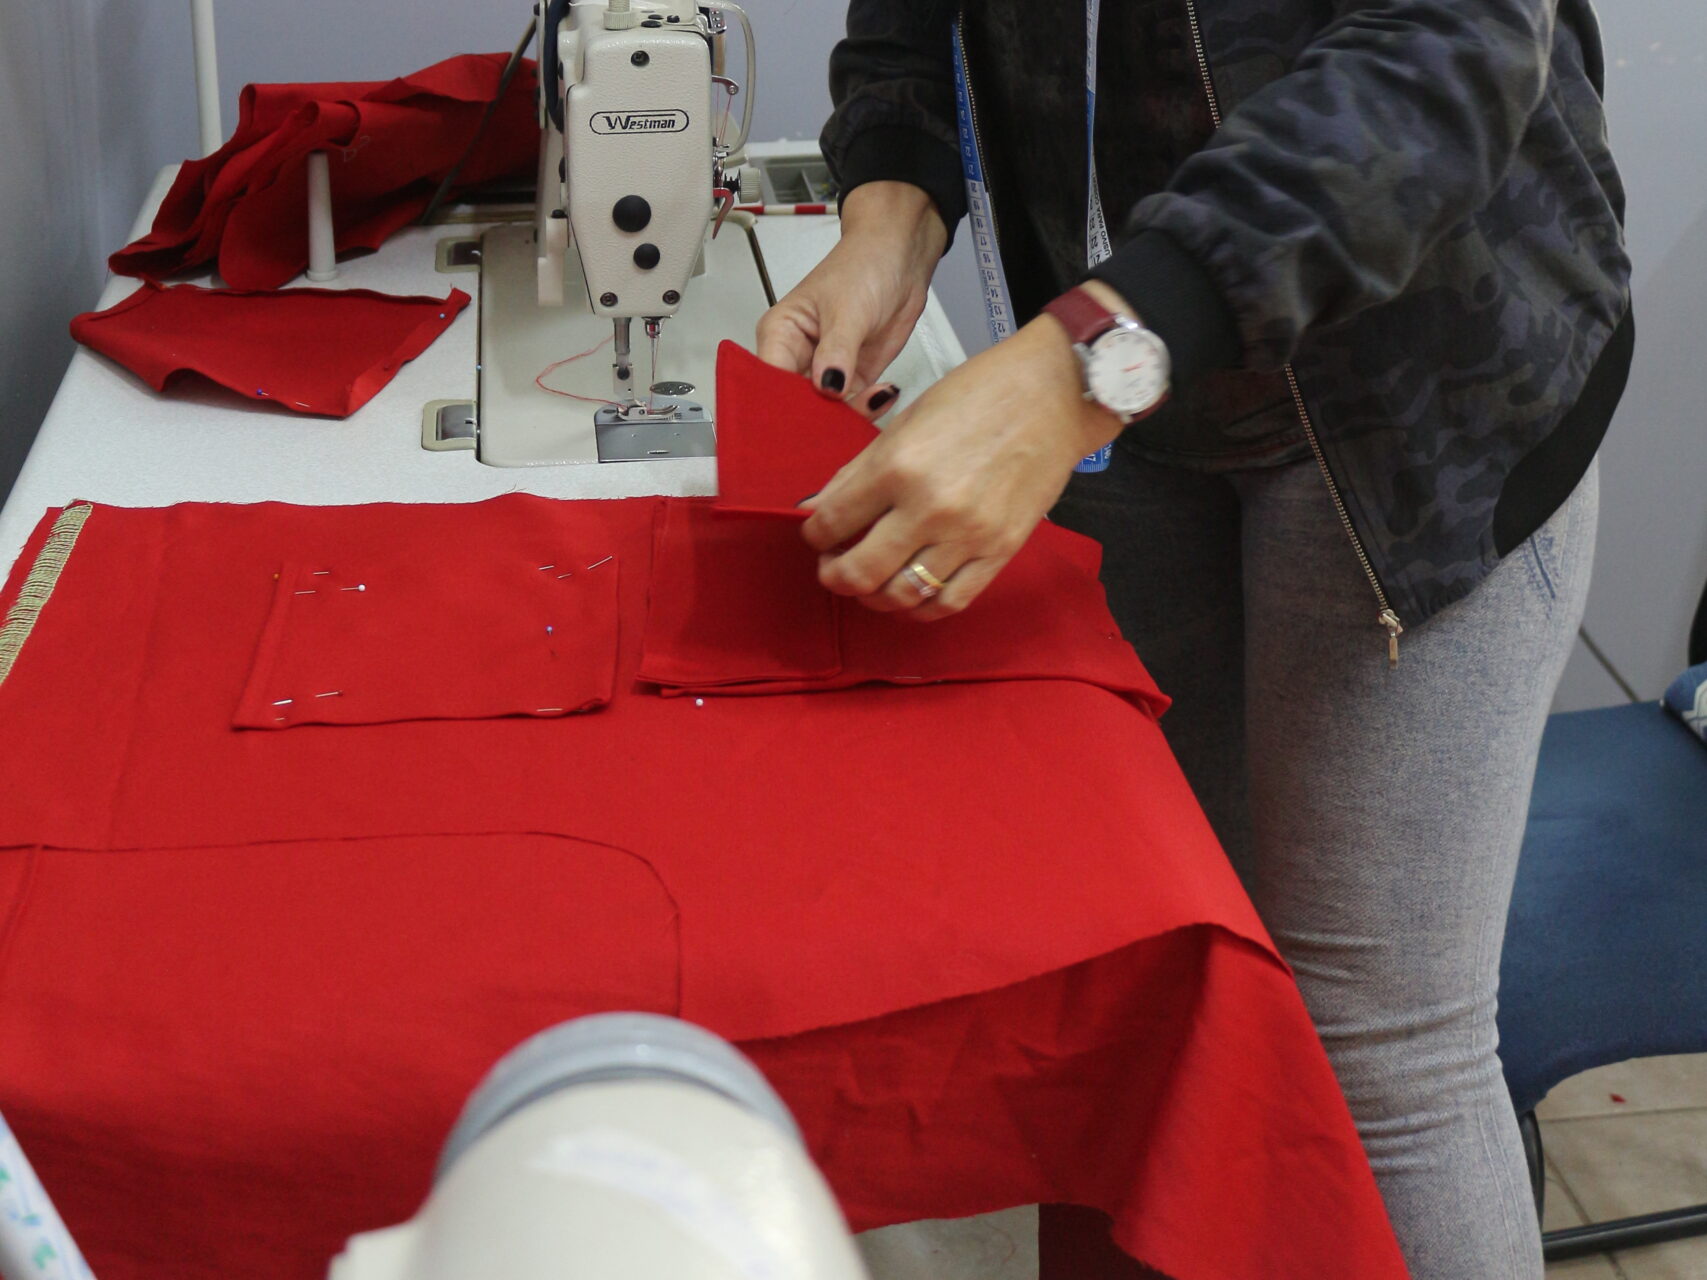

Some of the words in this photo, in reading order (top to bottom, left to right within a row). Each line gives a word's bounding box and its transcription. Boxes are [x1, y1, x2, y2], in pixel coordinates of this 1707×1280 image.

[602, 113, 676, 130] Westman
[980, 236, 987, 246] 17
[986, 271, 995, 281] 15
[990, 288, 999, 298] 14
[994, 305, 1002, 316] 13
[997, 322, 1006, 333] 12
